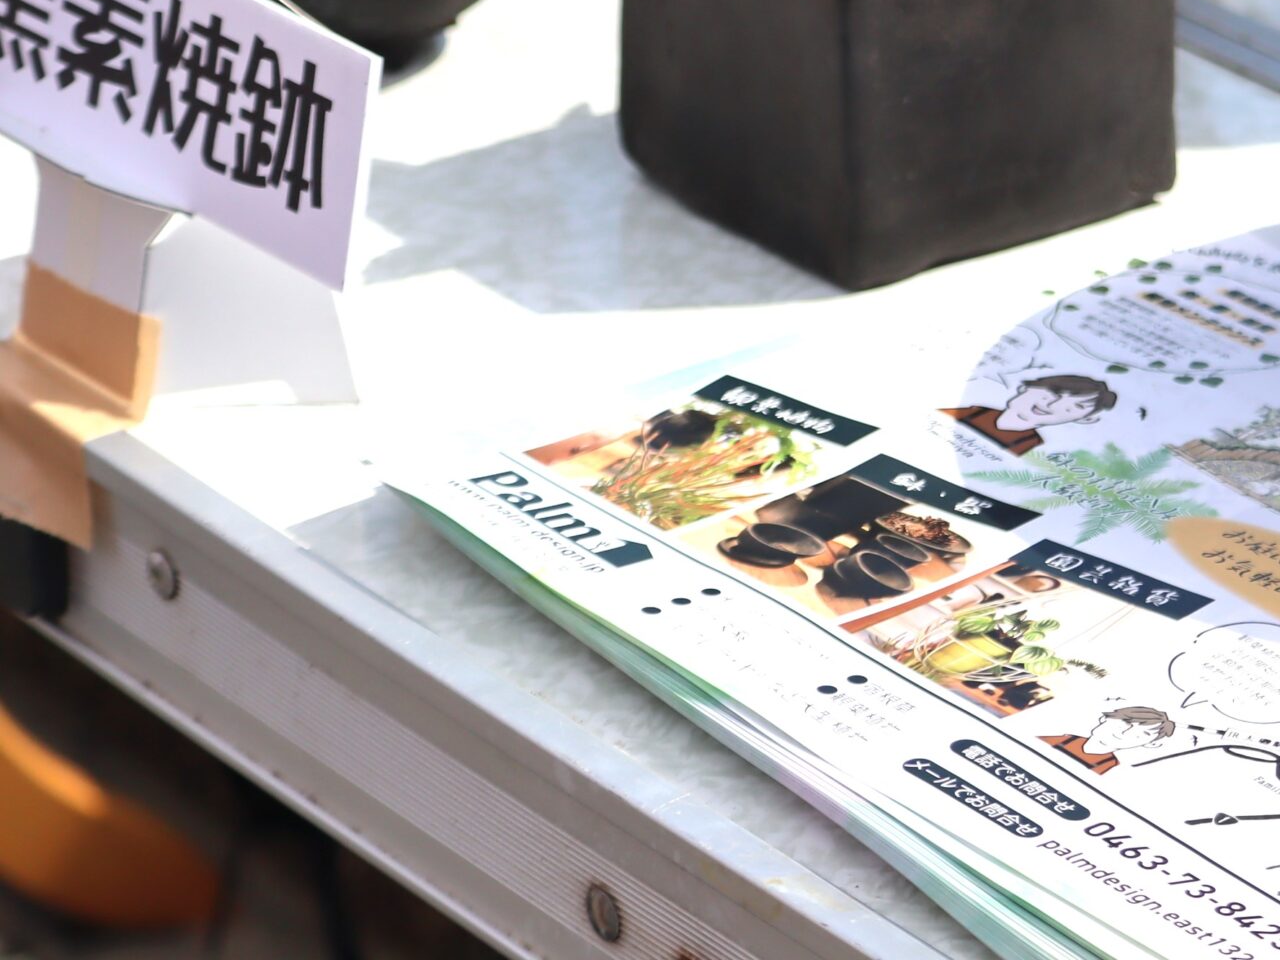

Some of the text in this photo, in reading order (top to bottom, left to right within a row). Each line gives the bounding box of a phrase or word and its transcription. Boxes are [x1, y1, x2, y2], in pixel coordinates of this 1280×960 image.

[467, 470, 602, 550] Palm
[1044, 552, 1179, 606] 園芸雑貨
[904, 761, 1038, 835] メールでお問合せ
[962, 745, 1075, 813] 電話でお問合せ
